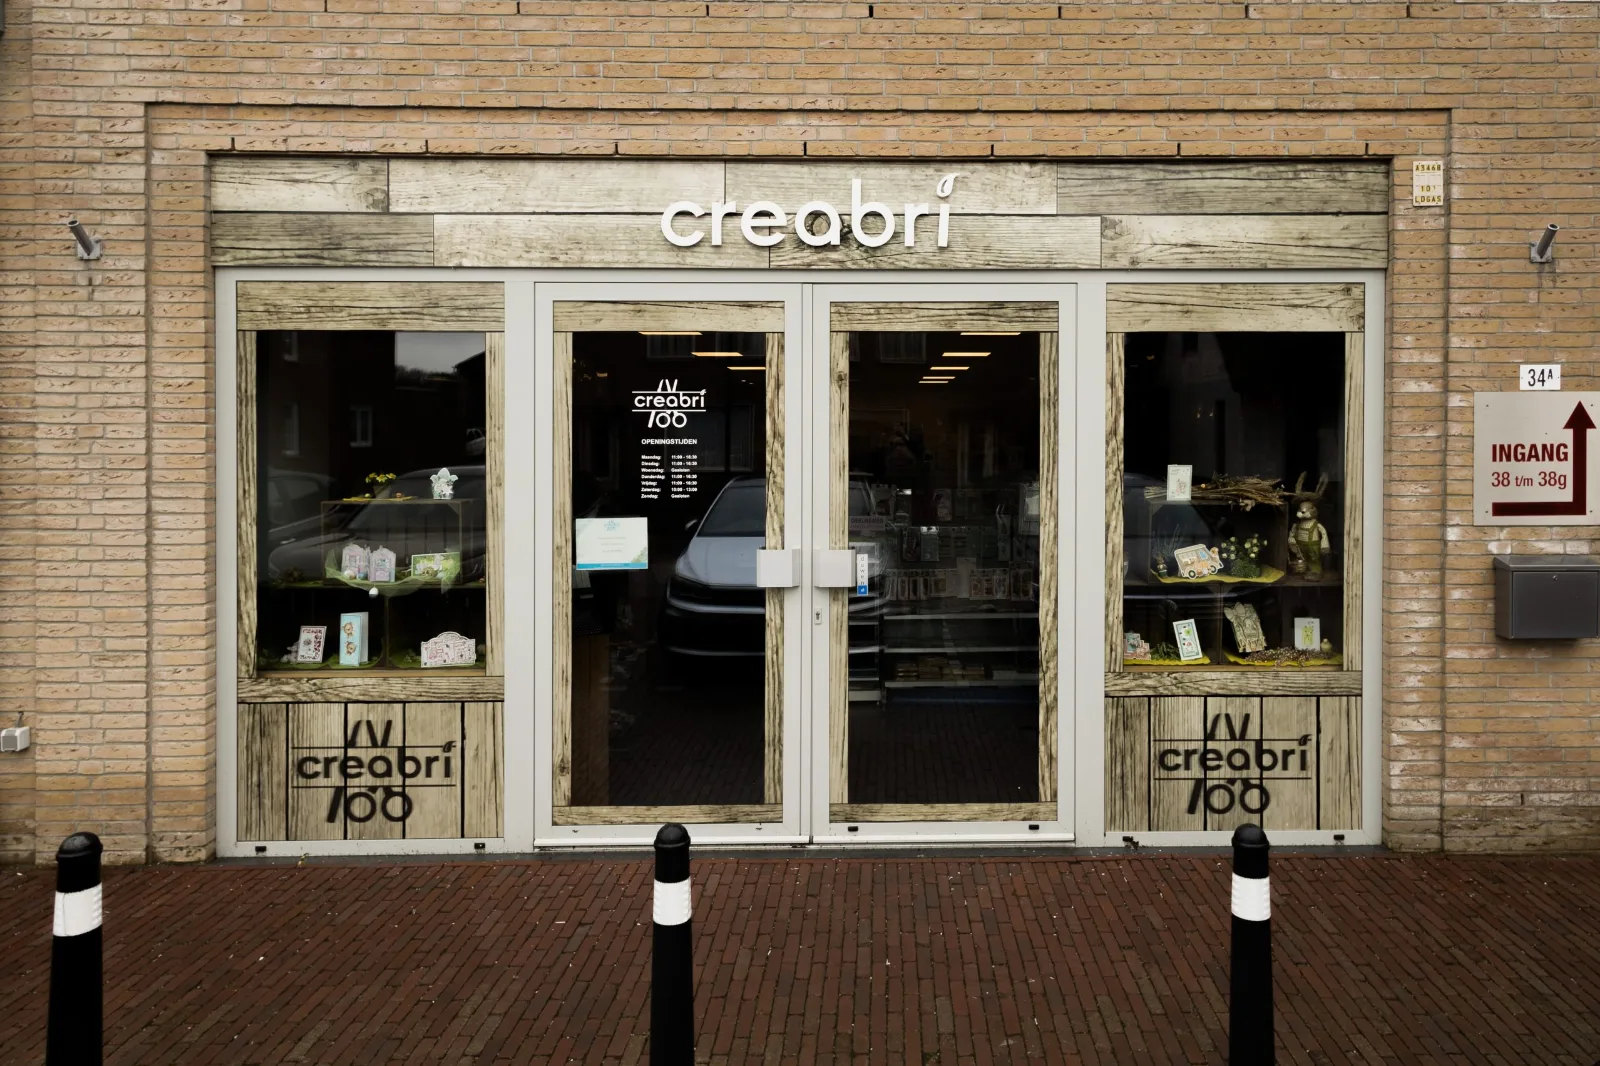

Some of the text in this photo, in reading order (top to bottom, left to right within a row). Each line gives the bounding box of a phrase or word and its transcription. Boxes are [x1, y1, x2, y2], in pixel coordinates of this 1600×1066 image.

[661, 173, 959, 247] creabri
[1527, 368, 1553, 387] 34A
[634, 389, 706, 408] creabri
[1491, 443, 1569, 463] INGANG
[1491, 471, 1567, 490] 38 t/m 38g
[297, 741, 456, 779] creabri
[1158, 734, 1312, 771] creabri
